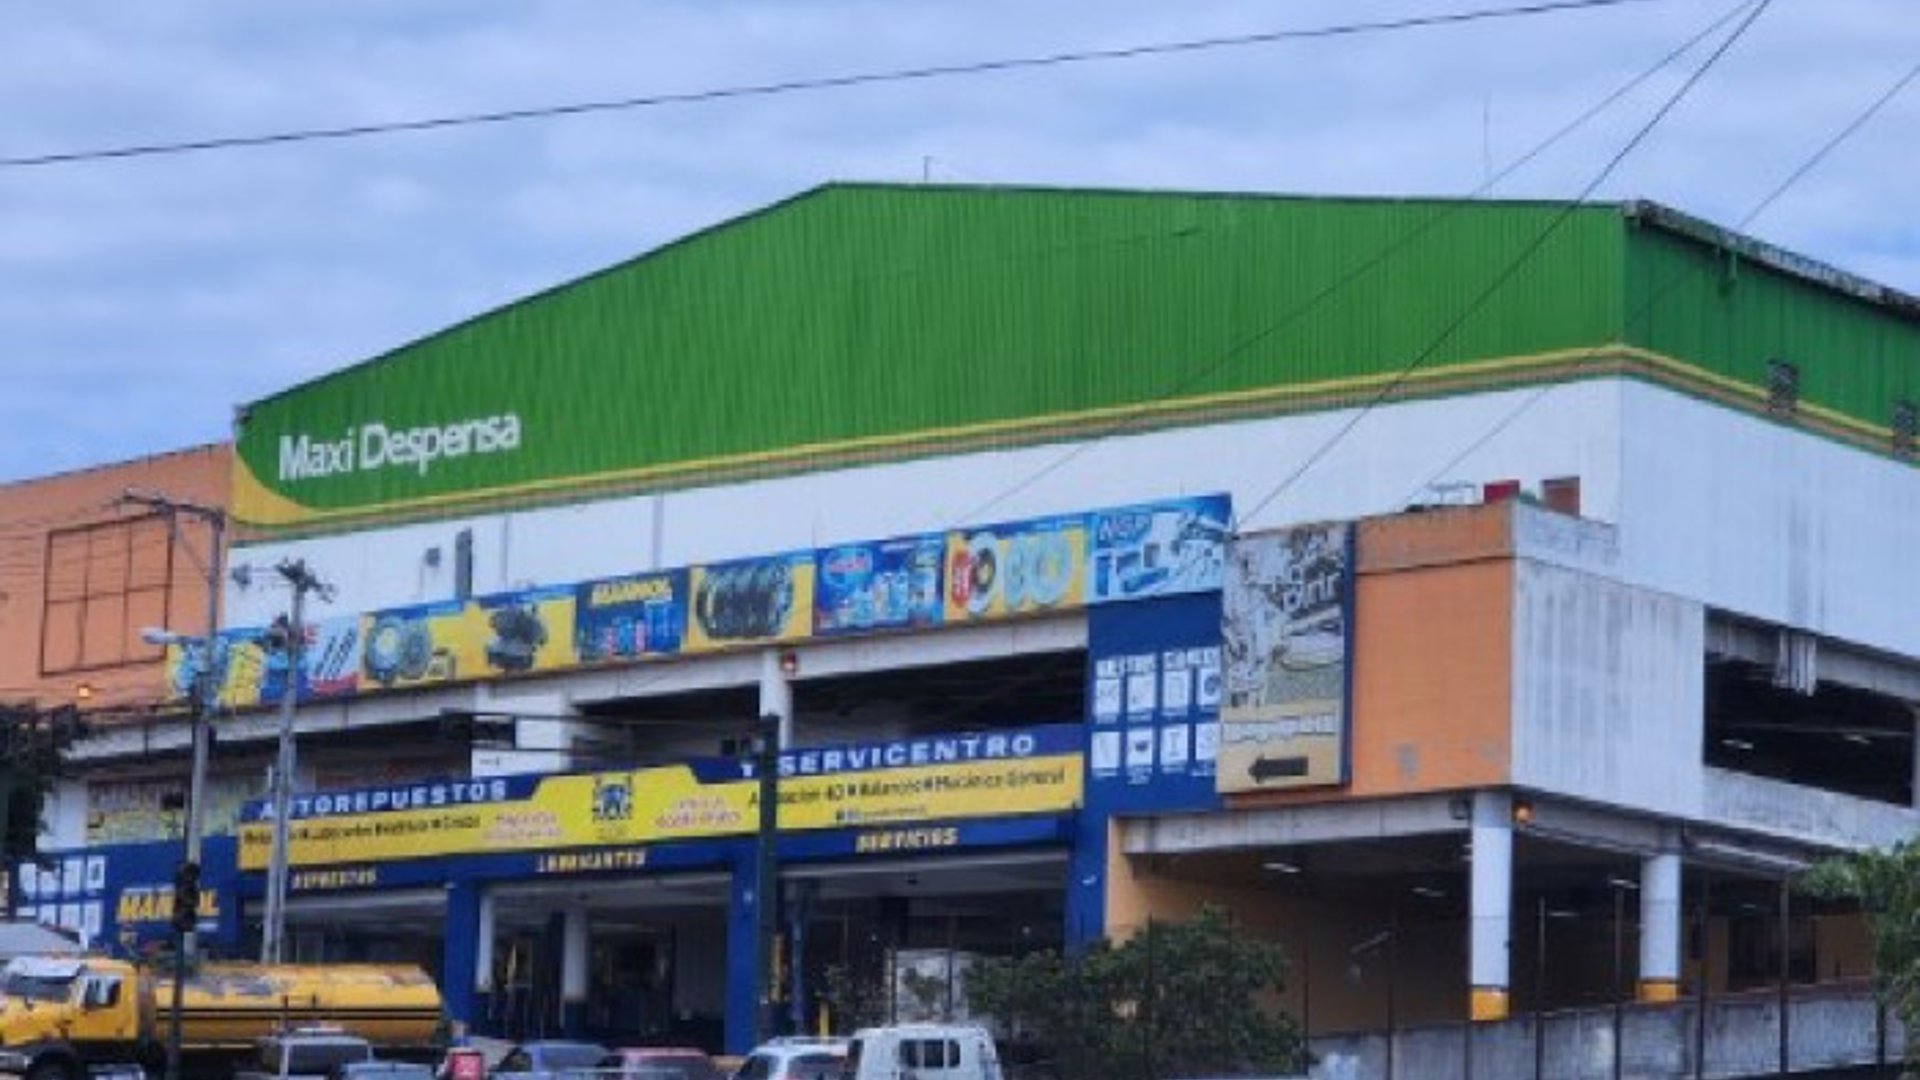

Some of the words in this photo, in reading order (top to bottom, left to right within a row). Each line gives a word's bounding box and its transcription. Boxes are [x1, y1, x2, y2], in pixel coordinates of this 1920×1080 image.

[279, 427, 353, 481] Maxi
[359, 413, 521, 477] Despensa
[778, 734, 1036, 777] SERVICENTRO
[260, 779, 507, 819] ATOREPUESTOS
